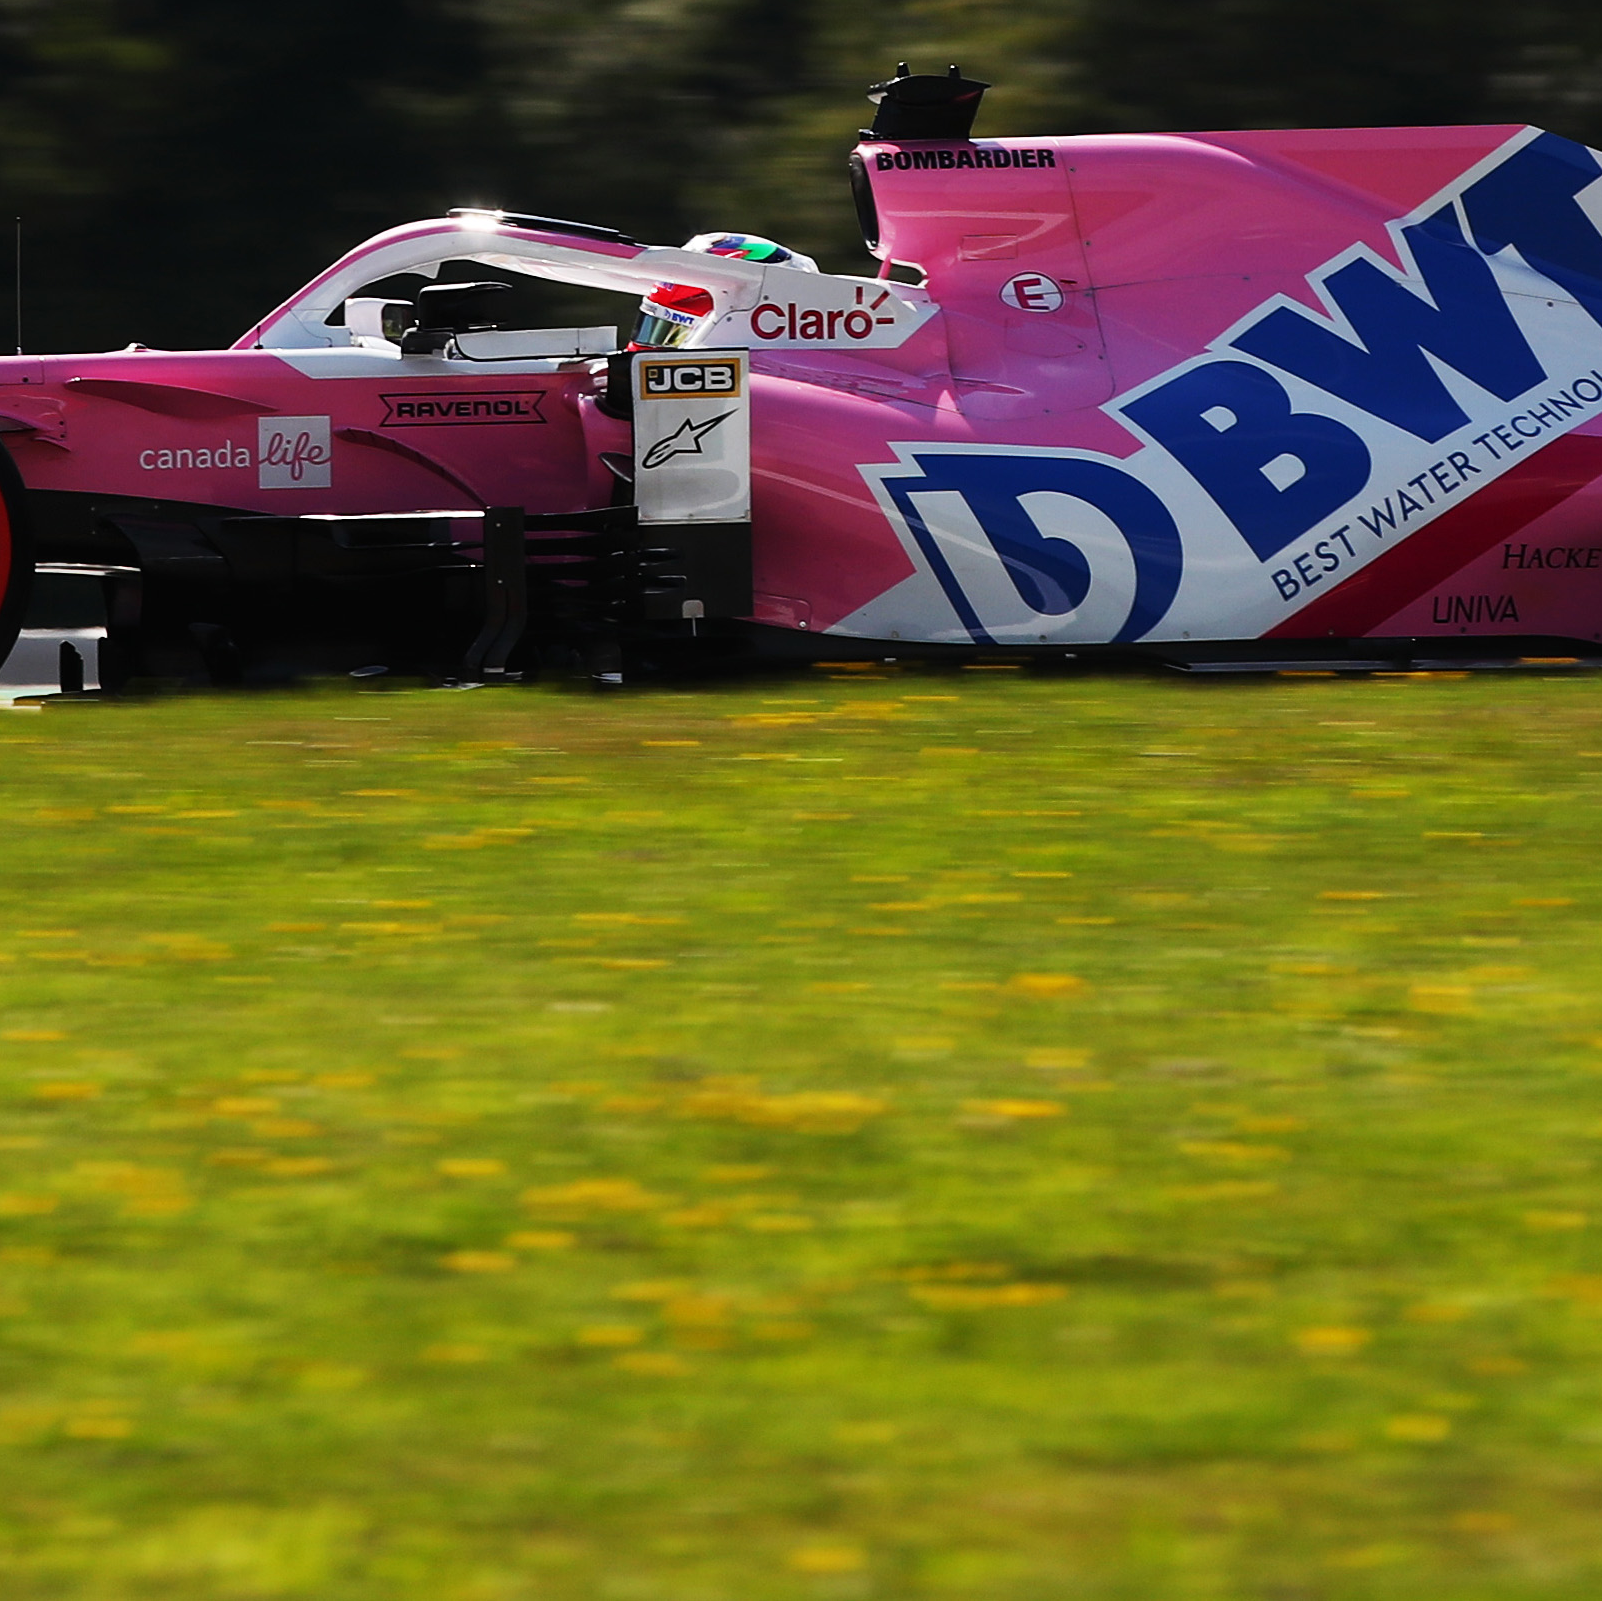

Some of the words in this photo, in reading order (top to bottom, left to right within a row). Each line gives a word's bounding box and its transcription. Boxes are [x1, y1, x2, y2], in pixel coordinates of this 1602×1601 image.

[876, 149, 1056, 171] BOMBARDIER
[1012, 278, 1050, 310] E
[750, 302, 873, 341] Claro
[649, 366, 733, 391] JCB
[396, 400, 530, 418] RAVENOL
[139, 439, 251, 470] canada
[258, 431, 332, 481] life
[1272, 526, 1359, 601] BEST
[1358, 451, 1482, 538] WATER
[1432, 595, 1520, 624] UNIVA
